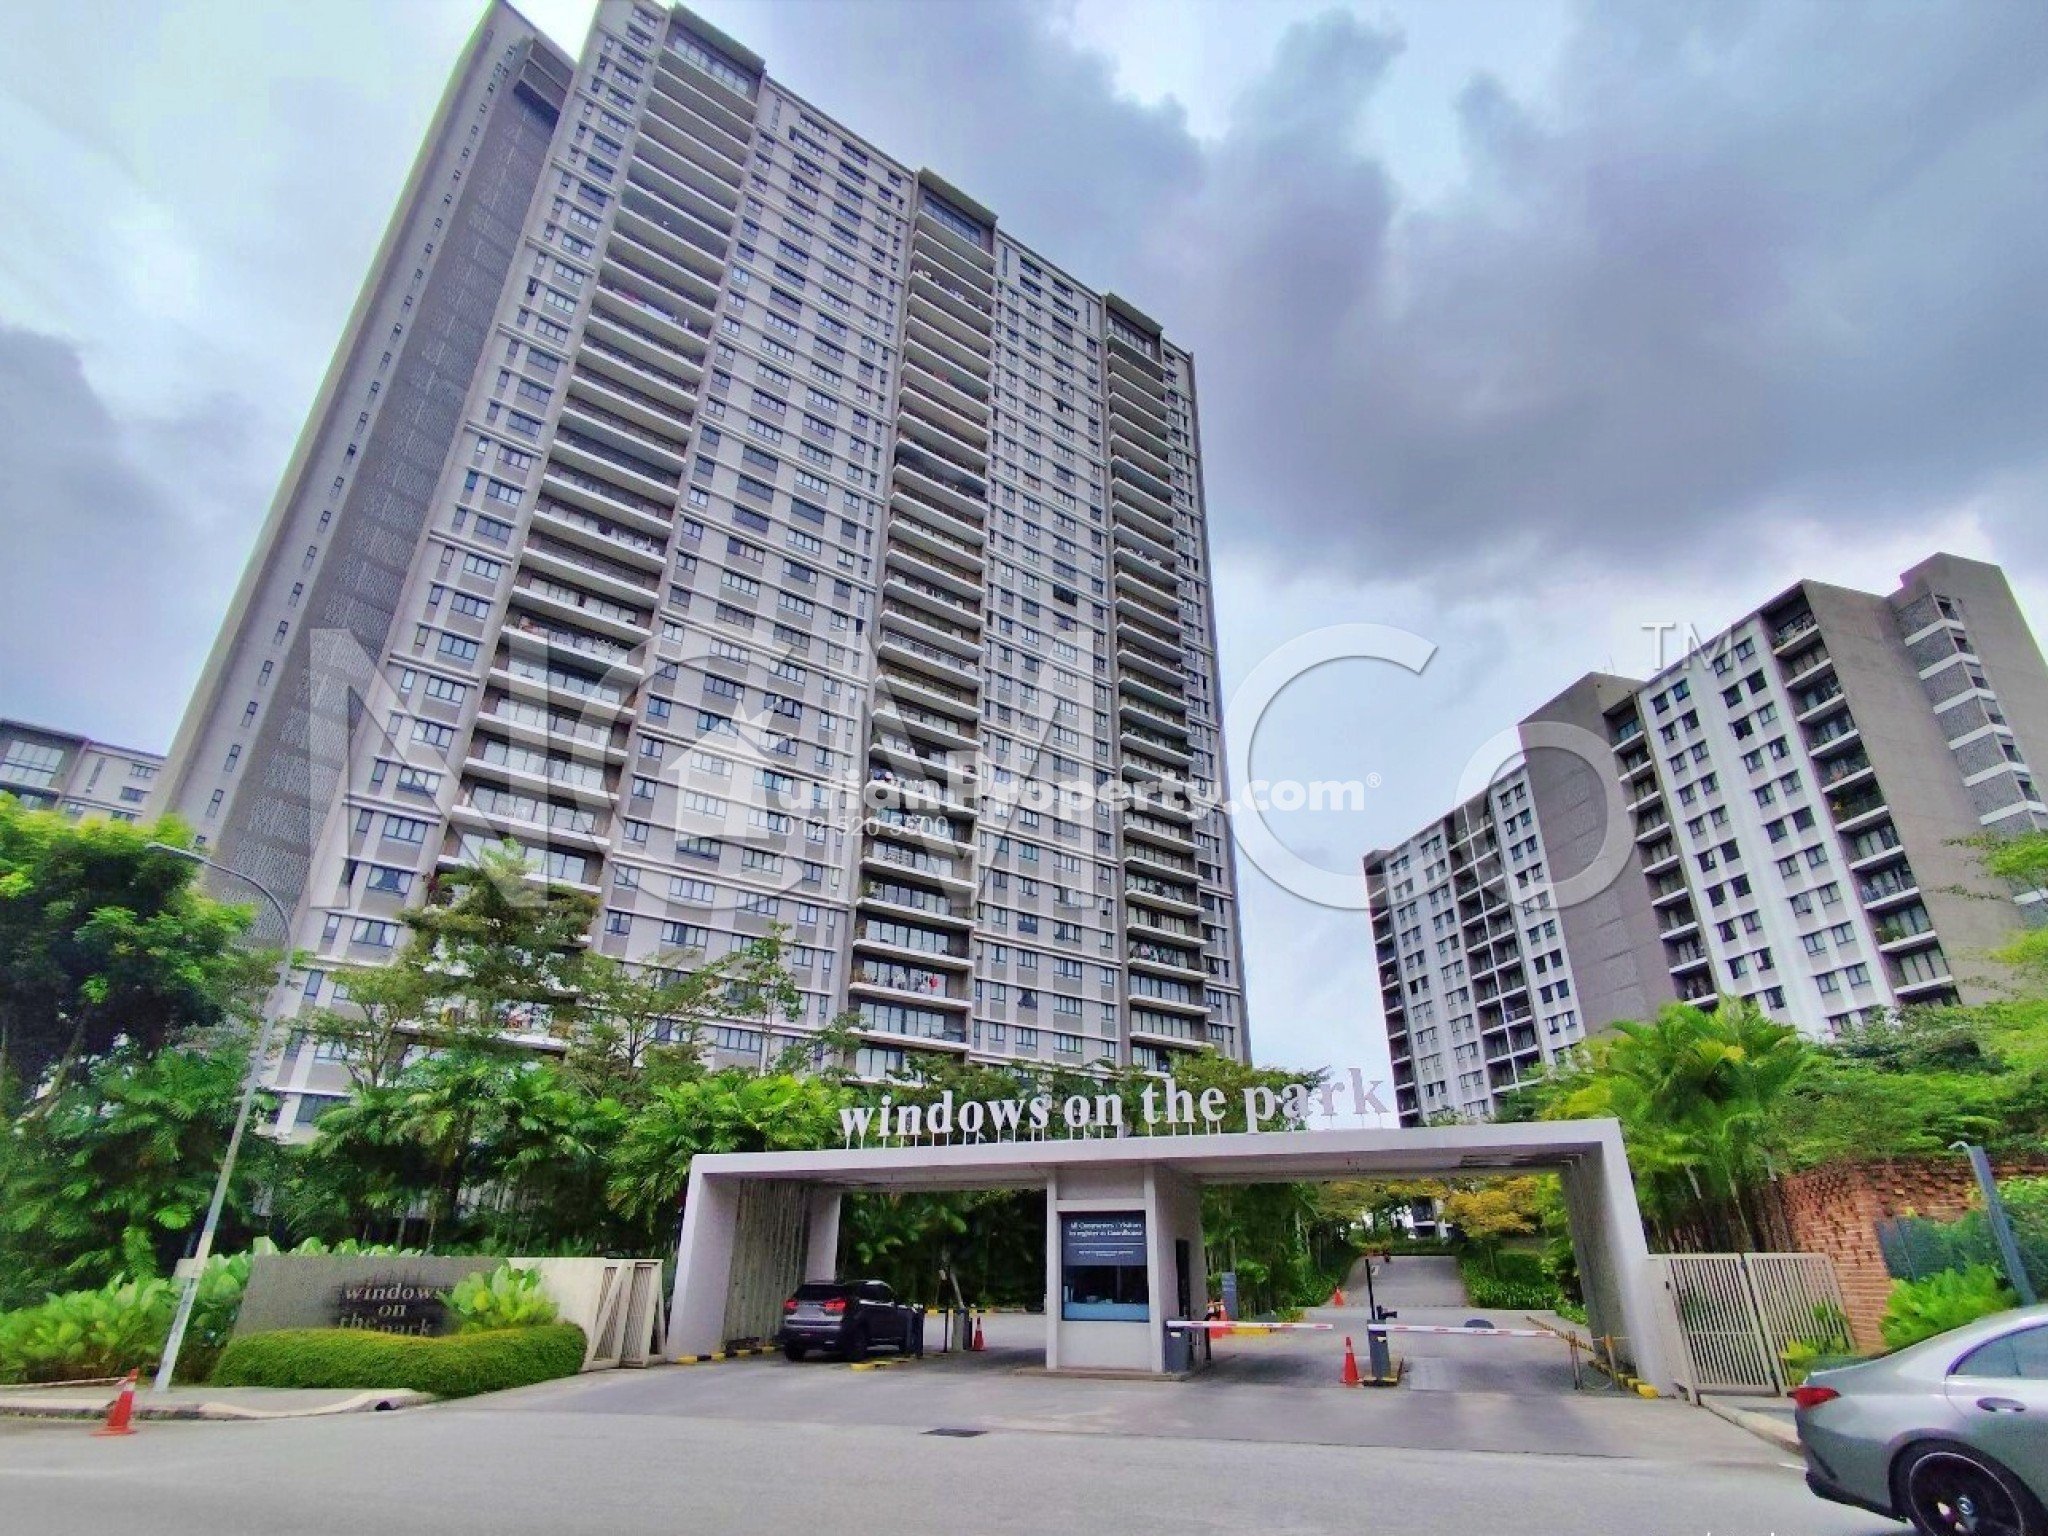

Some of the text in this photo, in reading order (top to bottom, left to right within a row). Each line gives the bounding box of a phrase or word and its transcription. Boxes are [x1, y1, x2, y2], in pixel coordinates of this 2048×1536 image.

[838, 1067, 1391, 1138] windows on the park
[378, 1304, 407, 1317] on
